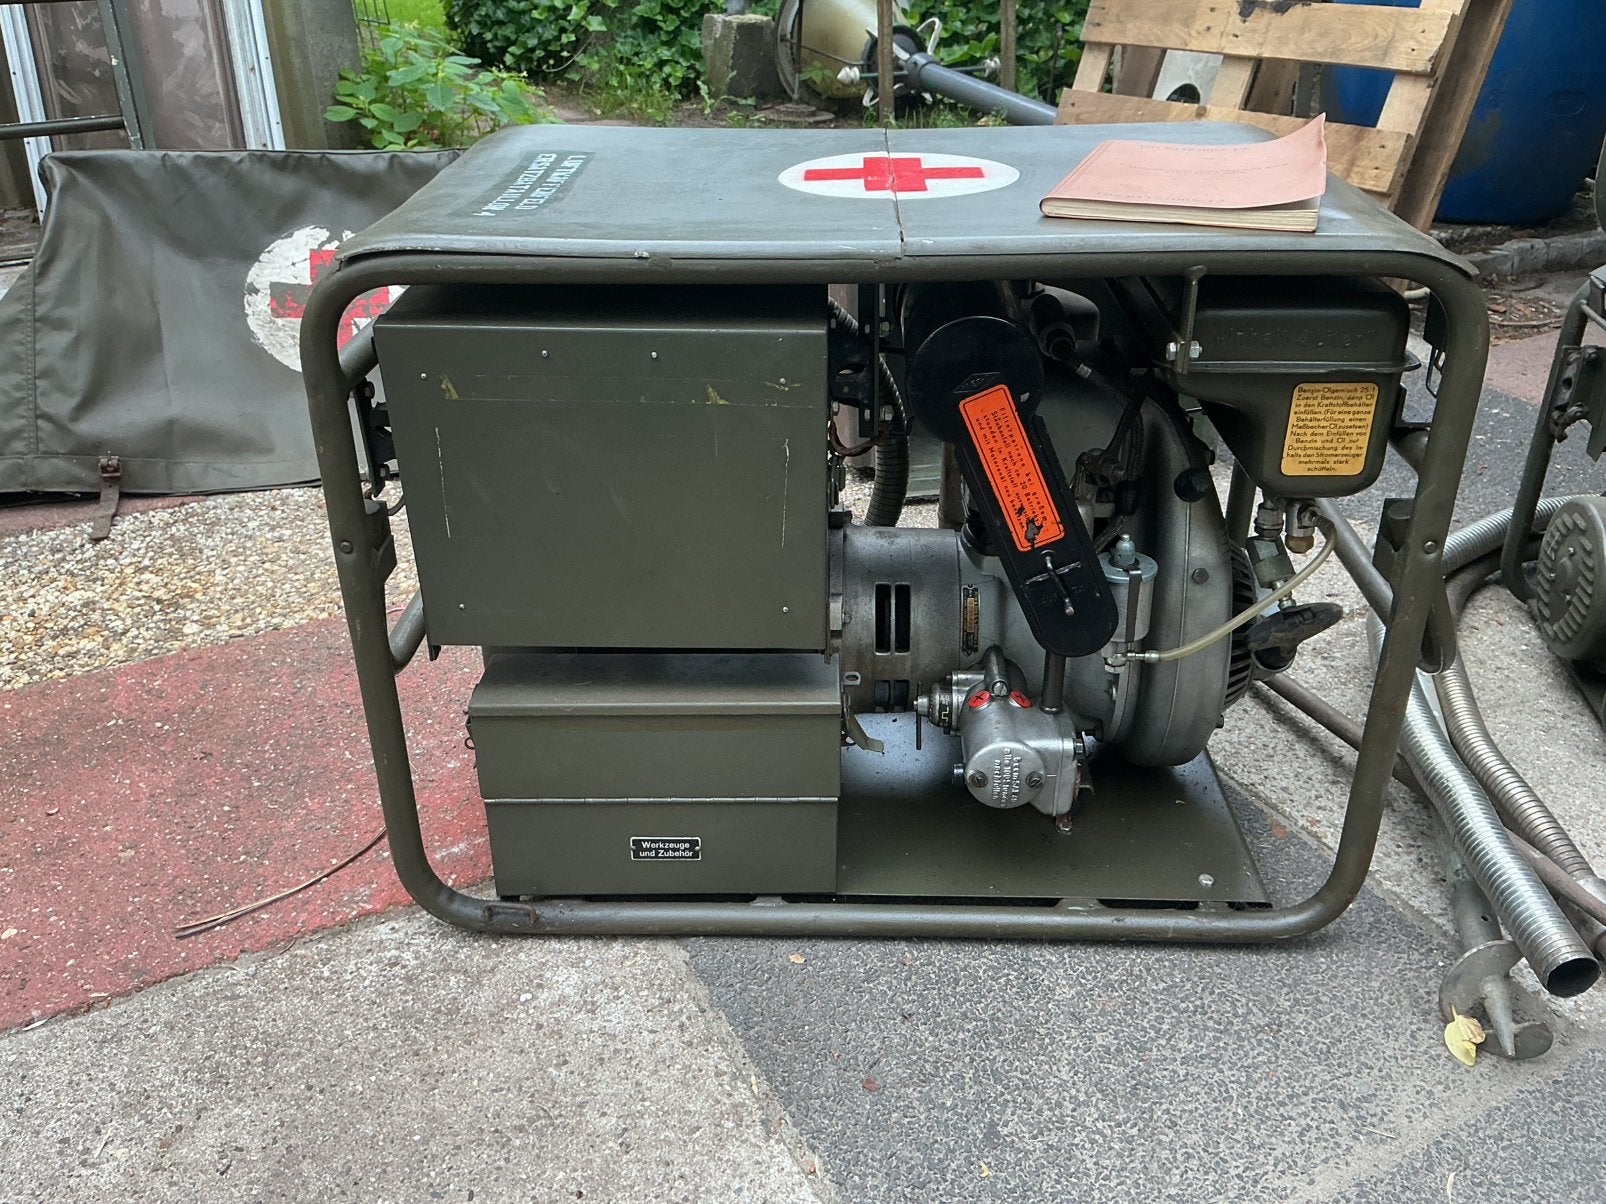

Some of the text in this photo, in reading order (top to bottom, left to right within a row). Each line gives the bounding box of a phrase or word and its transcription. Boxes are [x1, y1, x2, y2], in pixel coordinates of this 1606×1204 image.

[976, 417, 984, 430] und
[988, 447, 1006, 482] Motorenöl
[984, 414, 998, 443] stunden
[1001, 456, 1017, 488] Kraftstoff
[999, 407, 1048, 521] Filterpatrone bei großem
[1007, 450, 1017, 466] nach
[1020, 480, 1026, 489] 20
[641, 841, 690, 850] Werkzeuge
